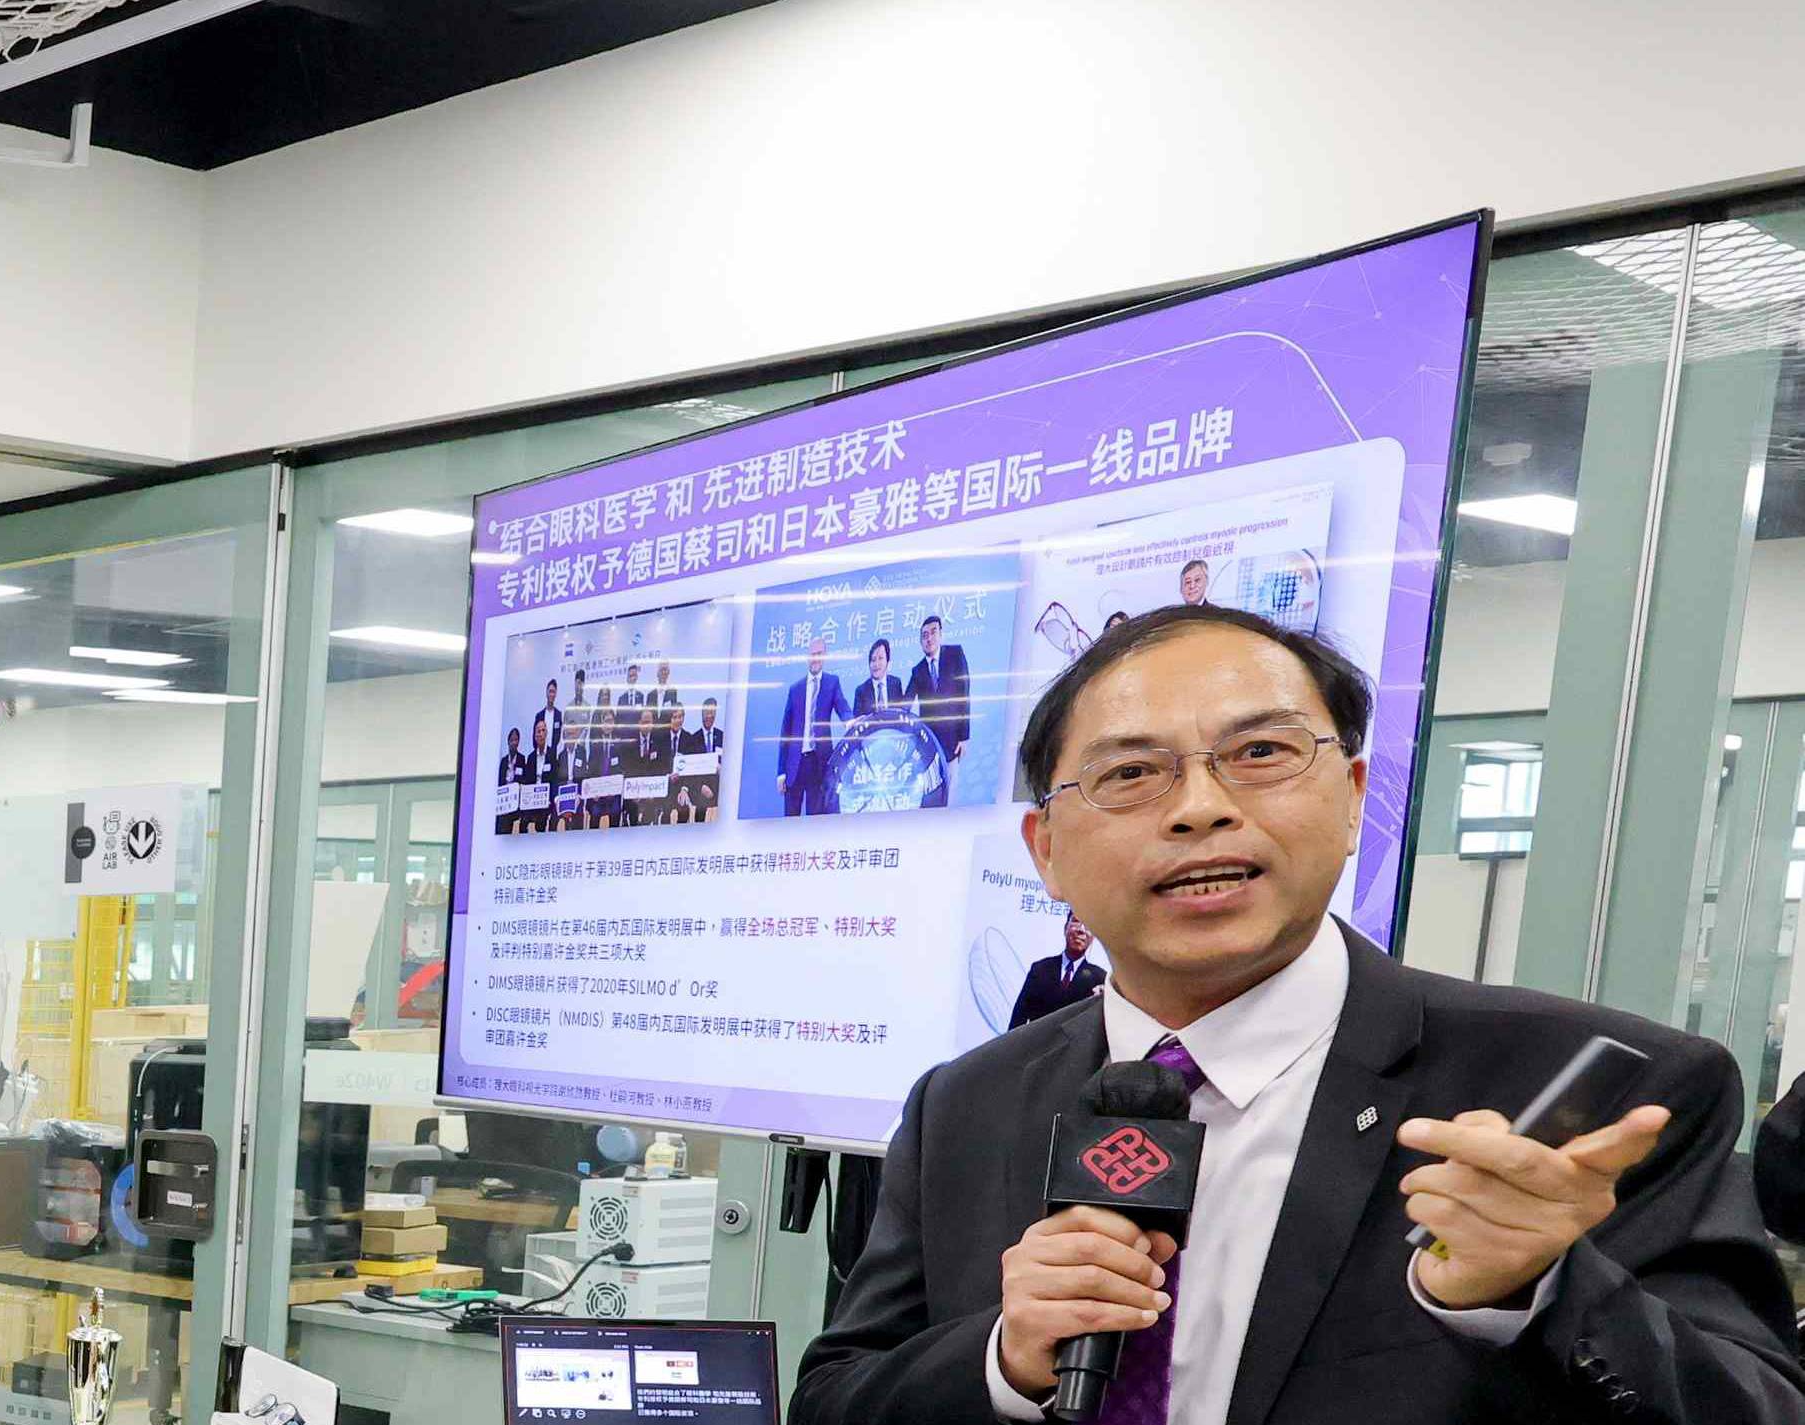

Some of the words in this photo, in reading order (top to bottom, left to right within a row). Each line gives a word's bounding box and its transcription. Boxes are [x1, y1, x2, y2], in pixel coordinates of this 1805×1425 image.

[499, 484, 657, 557] 结合眼科医学
[665, 475, 694, 521] 和
[702, 419, 907, 514] 先进制造技术
[497, 406, 1234, 608] 专利授权予德国蔡司和日本豪雅等国际一线品牌
[1238, 517, 1288, 535] progression
[806, 581, 853, 605] HOYA
[102, 861, 118, 870] LAB
[103, 852, 118, 861] AIR
[982, 869, 1013, 888] PolyU
